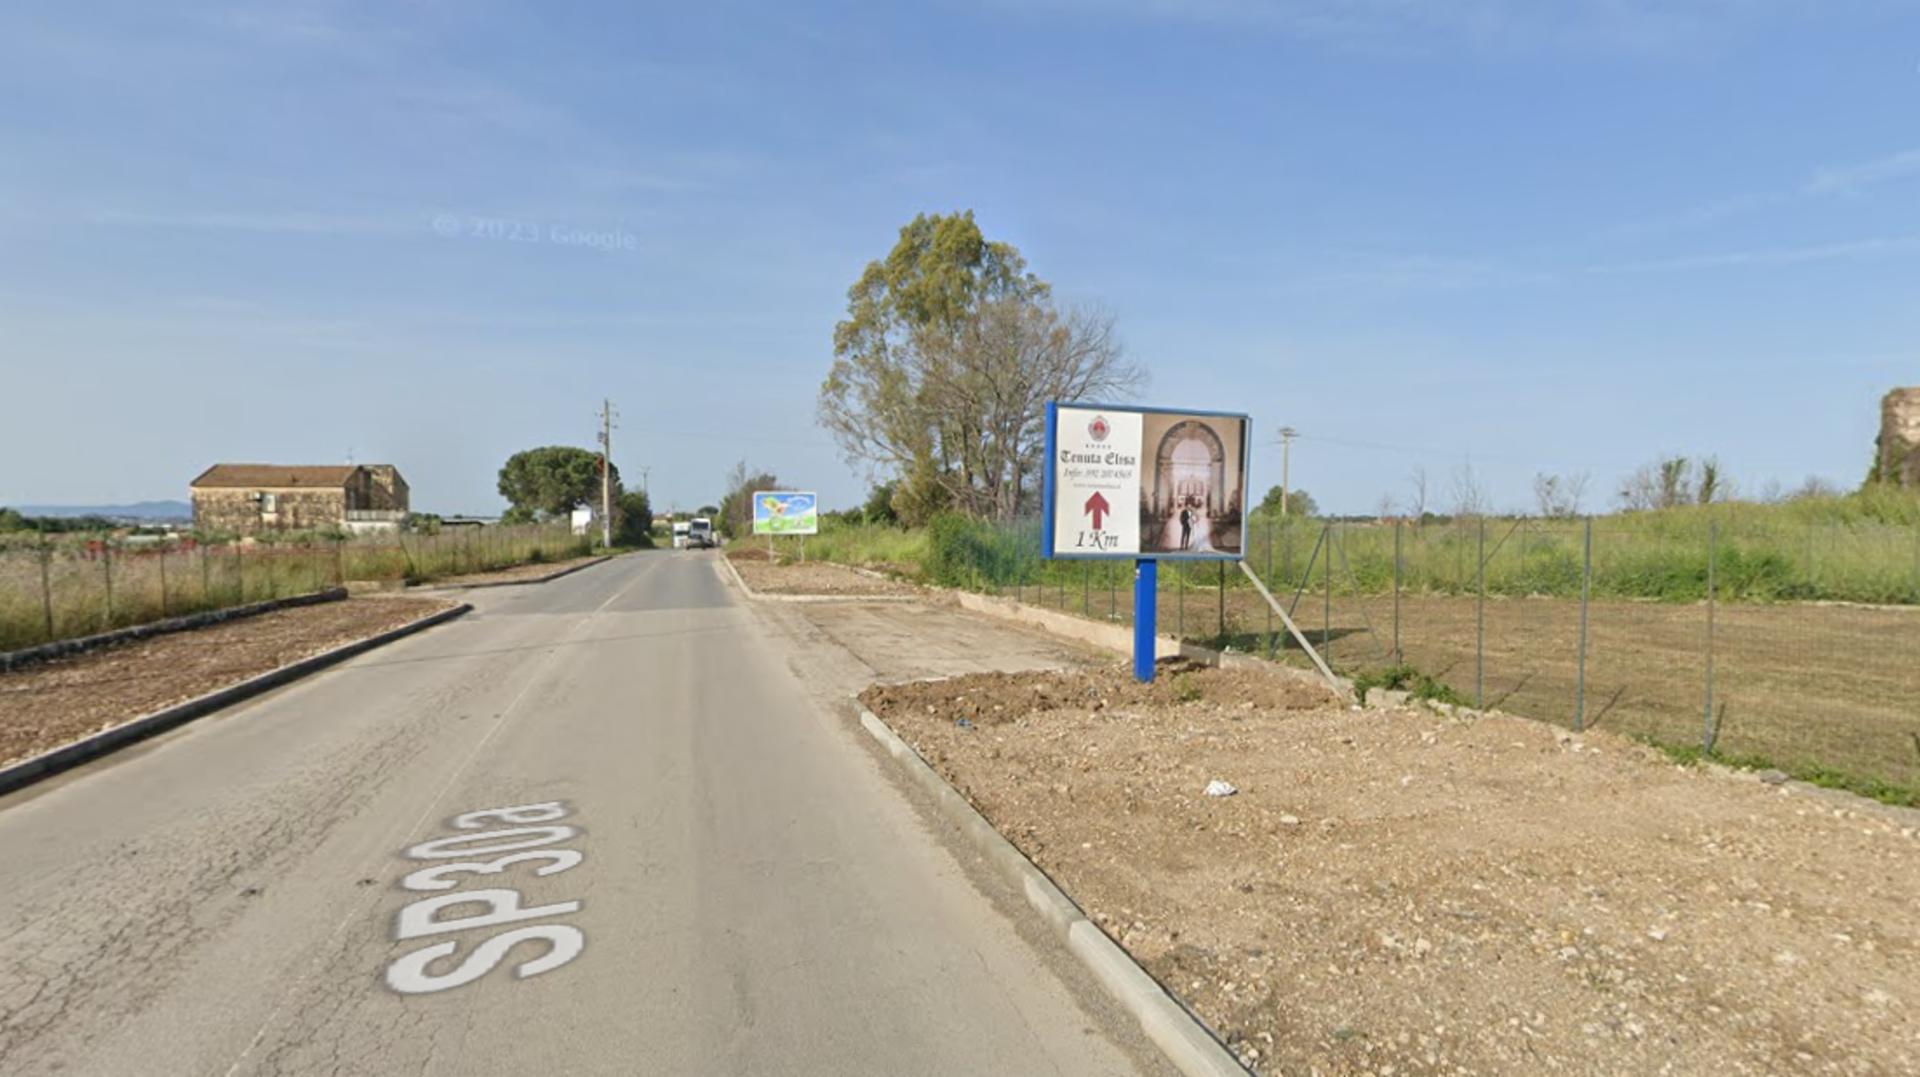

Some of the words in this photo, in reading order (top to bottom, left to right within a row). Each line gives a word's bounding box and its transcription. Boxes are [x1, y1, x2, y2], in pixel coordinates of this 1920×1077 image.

[1060, 450, 1101, 464] Tenuta
[1104, 451, 1135, 465] Elisa
[1075, 530, 1085, 548] 1
[1089, 530, 1119, 551] Km
